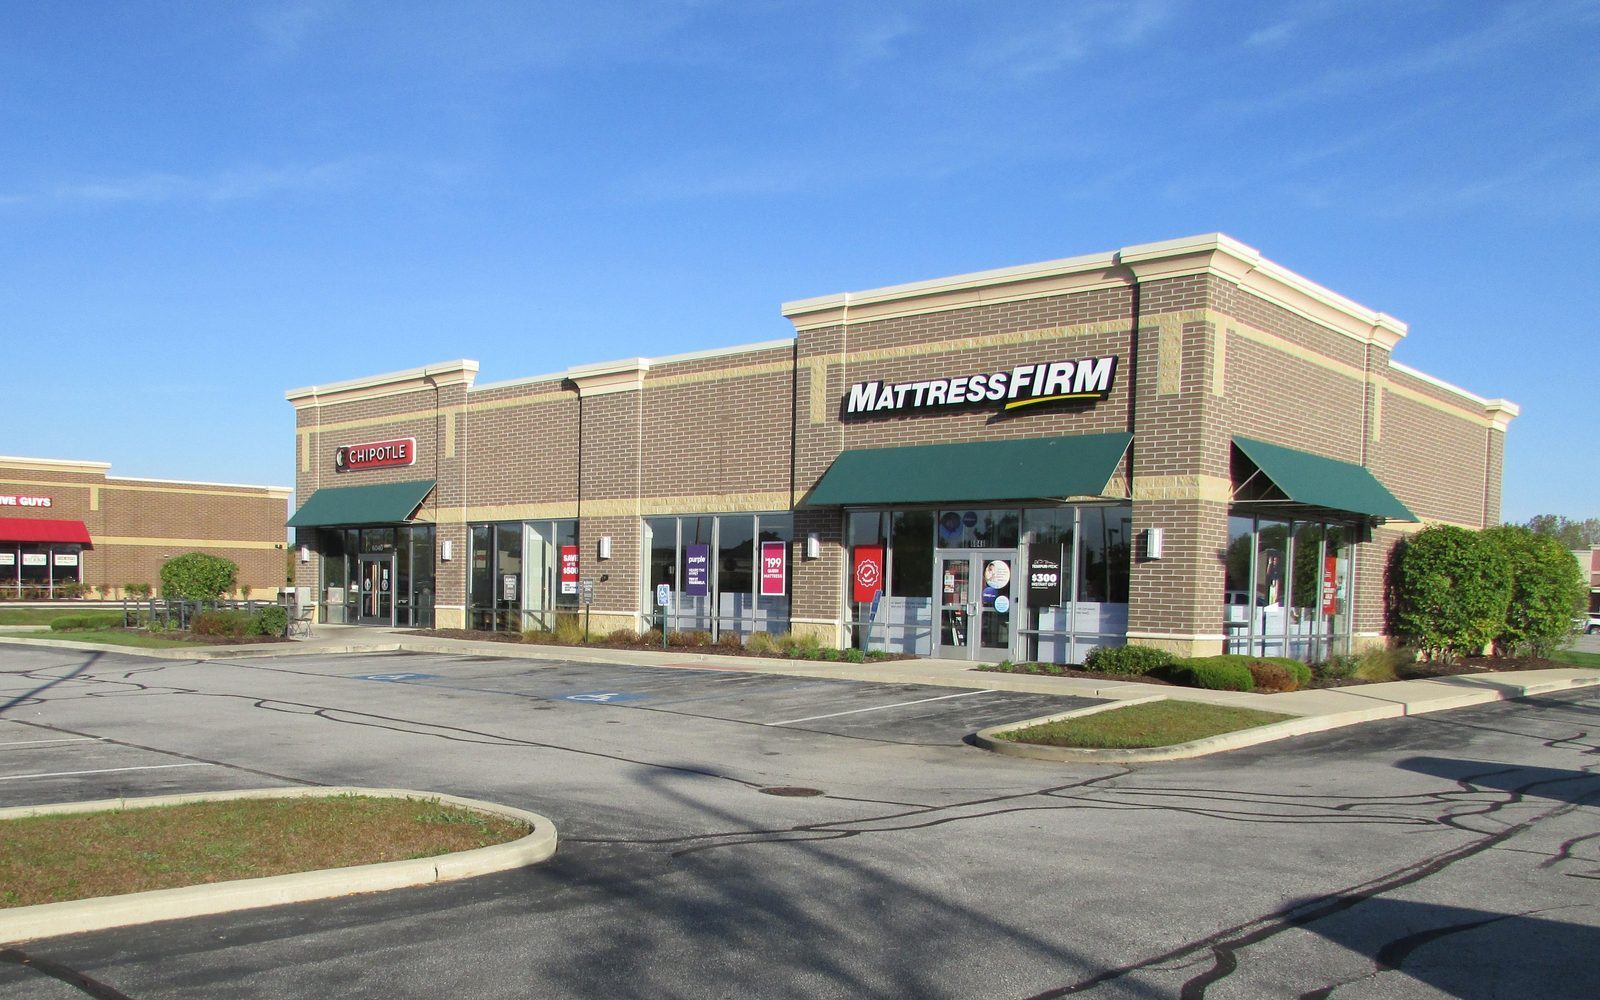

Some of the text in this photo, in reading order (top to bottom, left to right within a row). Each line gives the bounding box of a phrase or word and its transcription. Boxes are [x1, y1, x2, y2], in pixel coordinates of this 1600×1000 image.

[349, 444, 406, 463] CHIPOTLE
[19, 496, 51, 507] GUYS
[688, 556, 706, 564] purple
[1031, 574, 1057, 582] $300
